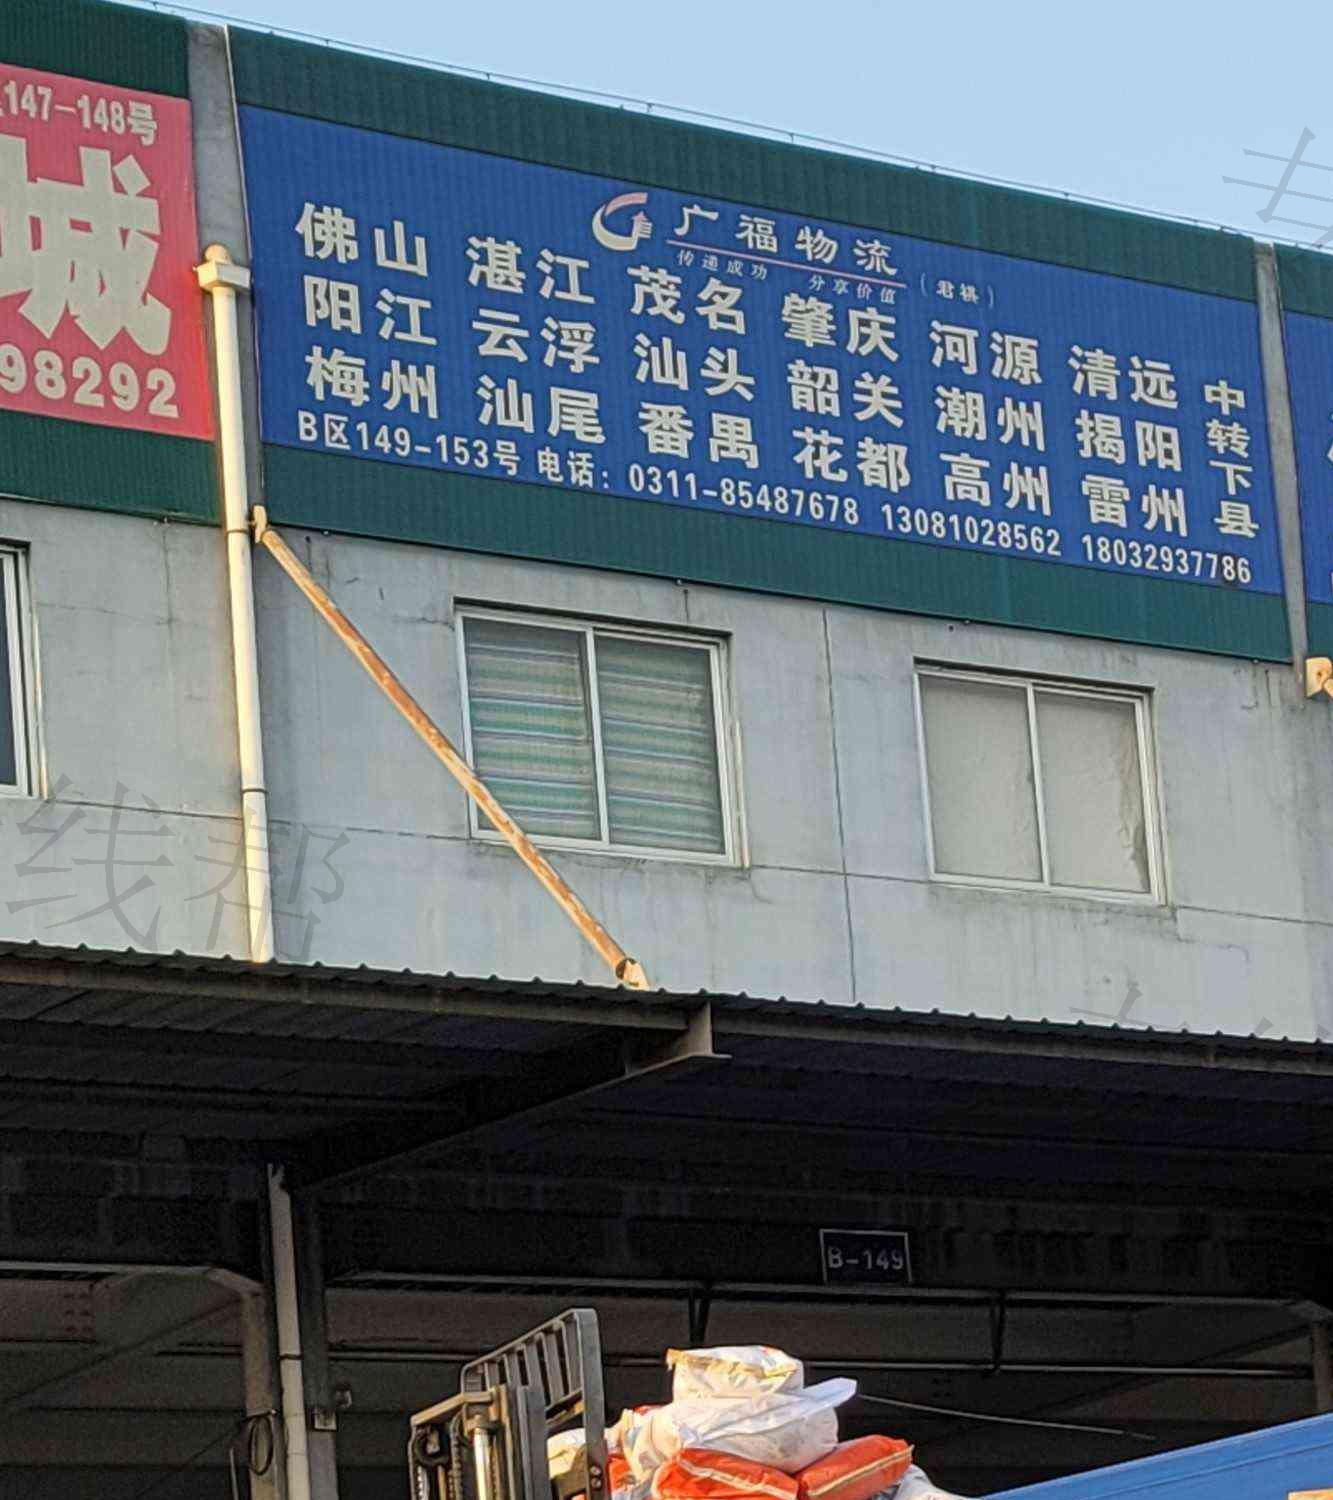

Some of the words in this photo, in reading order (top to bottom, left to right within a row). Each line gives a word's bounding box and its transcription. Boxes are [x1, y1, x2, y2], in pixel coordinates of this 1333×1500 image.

[0, 79, 157, 146] 147-148号
[674, 204, 897, 276] 广福物流
[676, 249, 768, 281] 传递成功
[808, 274, 896, 305] 分享价值
[295, 202, 428, 277] 佛山
[465, 235, 595, 305] 湛江
[627, 264, 746, 336] 茂名
[781, 293, 899, 362] 肇庆
[929, 321, 1044, 386] 河源
[1069, 344, 1180, 409] 清远
[0, 343, 179, 418] 98292
[303, 275, 437, 346] 阳江
[472, 307, 600, 374] 云浮
[632, 333, 756, 402] 汕头
[786, 359, 904, 429] 韶关
[934, 385, 1045, 452] 潮州
[1074, 409, 1182, 472] 揭阳
[298, 410, 520, 475] B区149-153号
[628, 470, 859, 526] 0311-85487678
[881, 504, 1063, 557] 13081028562
[1081, 535, 1252, 585] 18032937786
[305, 345, 439, 420] 梅州
[474, 374, 606, 445] 汕尾
[638, 401, 760, 470] 番禺
[792, 427, 911, 495] 花都
[939, 450, 1052, 516] 高州
[1080, 475, 1188, 537] 雷州
[1203, 381, 1260, 540] 中转下县
[828, 1246, 904, 1271] B-149
